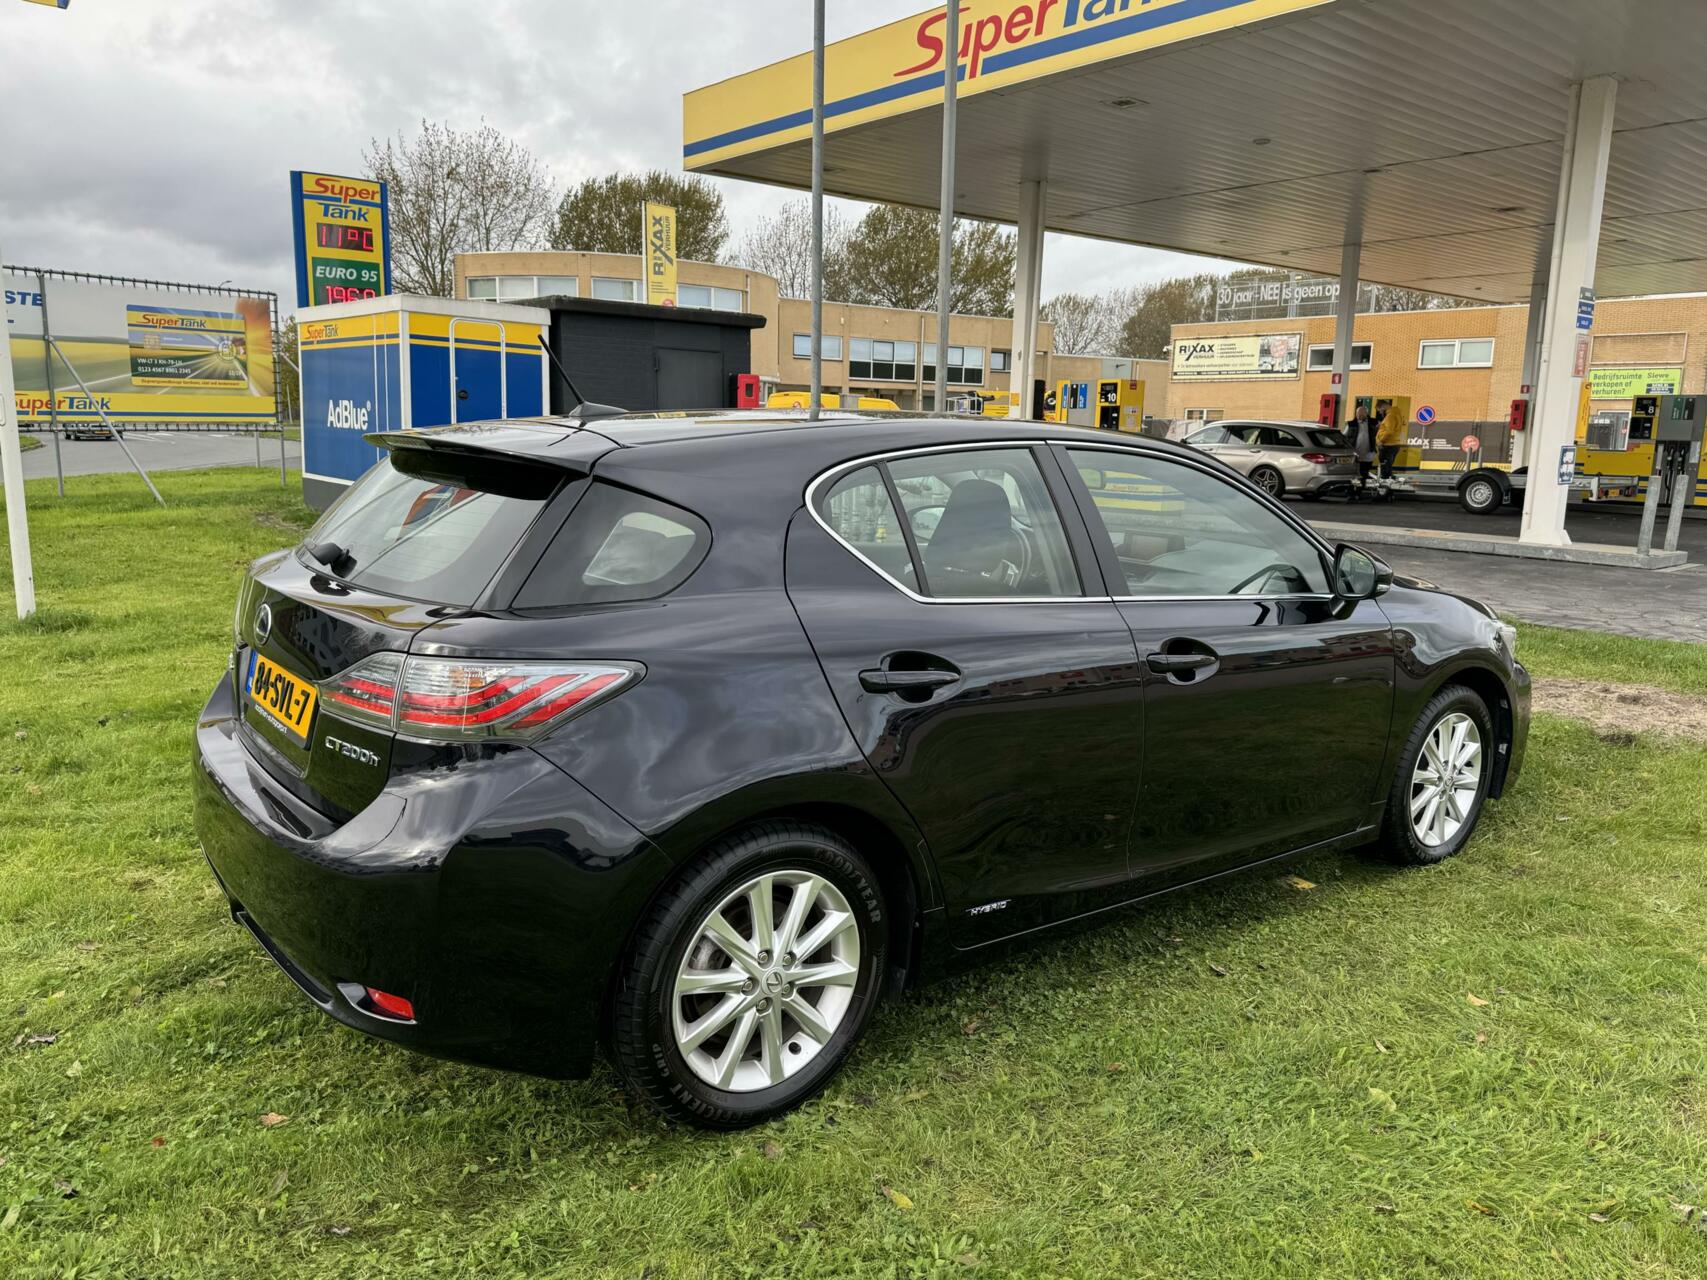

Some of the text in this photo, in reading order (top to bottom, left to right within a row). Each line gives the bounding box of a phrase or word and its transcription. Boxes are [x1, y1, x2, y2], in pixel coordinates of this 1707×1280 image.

[304, 178, 380, 204] Super
[317, 202, 369, 222] Tank
[316, 266, 378, 282] EURO 95
[1260, 284, 1279, 301] NEE
[1294, 286, 1322, 303] geen
[136, 313, 207, 330] SuperTank
[1179, 343, 1214, 361] RIXAX
[1592, 381, 1623, 389] verkopen
[1593, 373, 1642, 381] Bedrijfsruimte
[15, 393, 111, 416] uperTank
[1107, 392, 1116, 402] 10
[1648, 405, 1654, 414] 8
[255, 661, 311, 726] 84-SVL-7
[325, 735, 379, 767] CT200h
